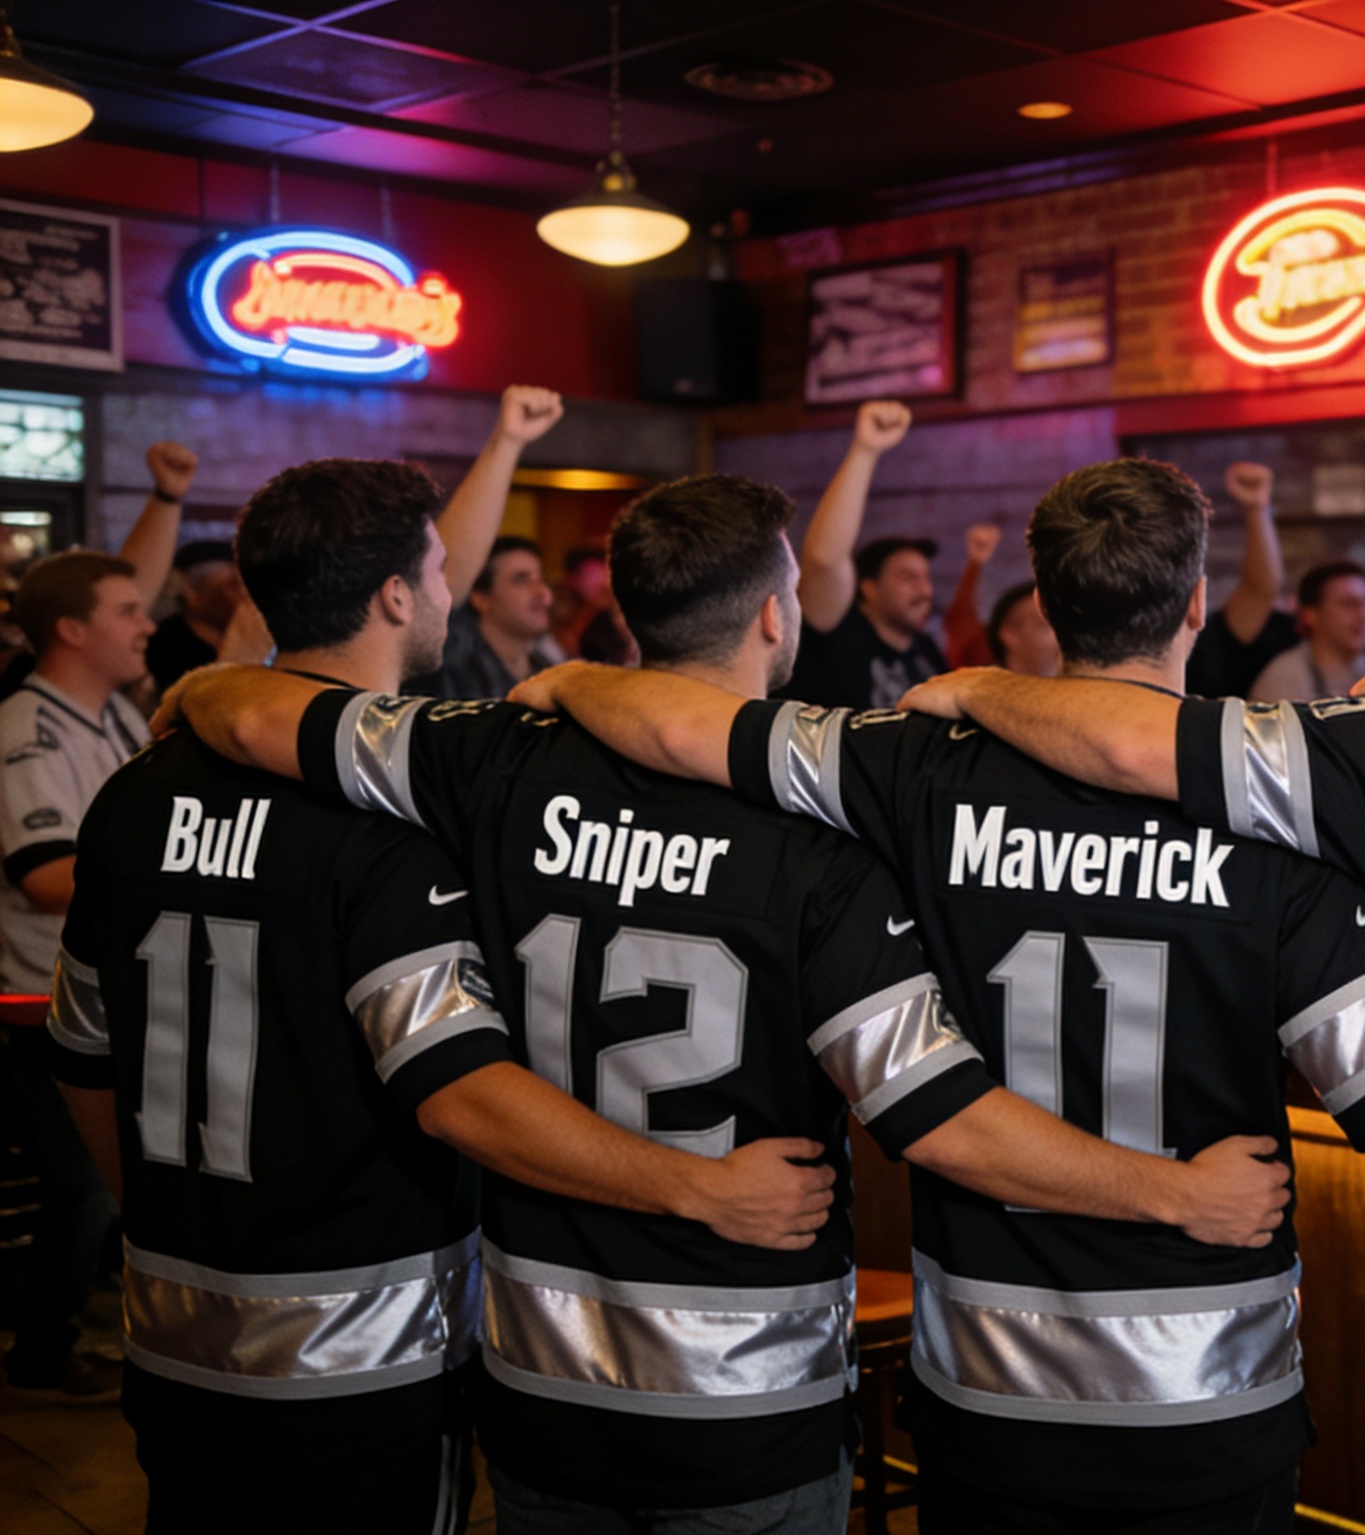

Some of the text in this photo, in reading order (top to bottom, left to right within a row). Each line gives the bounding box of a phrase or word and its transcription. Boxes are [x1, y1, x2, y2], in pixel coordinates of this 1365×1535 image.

[161, 796, 271, 880] Bull
[534, 795, 731, 907] Sniper
[948, 803, 1235, 908] Maverick
[136, 910, 260, 1183] 11
[515, 913, 749, 1159] 12
[986, 930, 1178, 1160] 11
